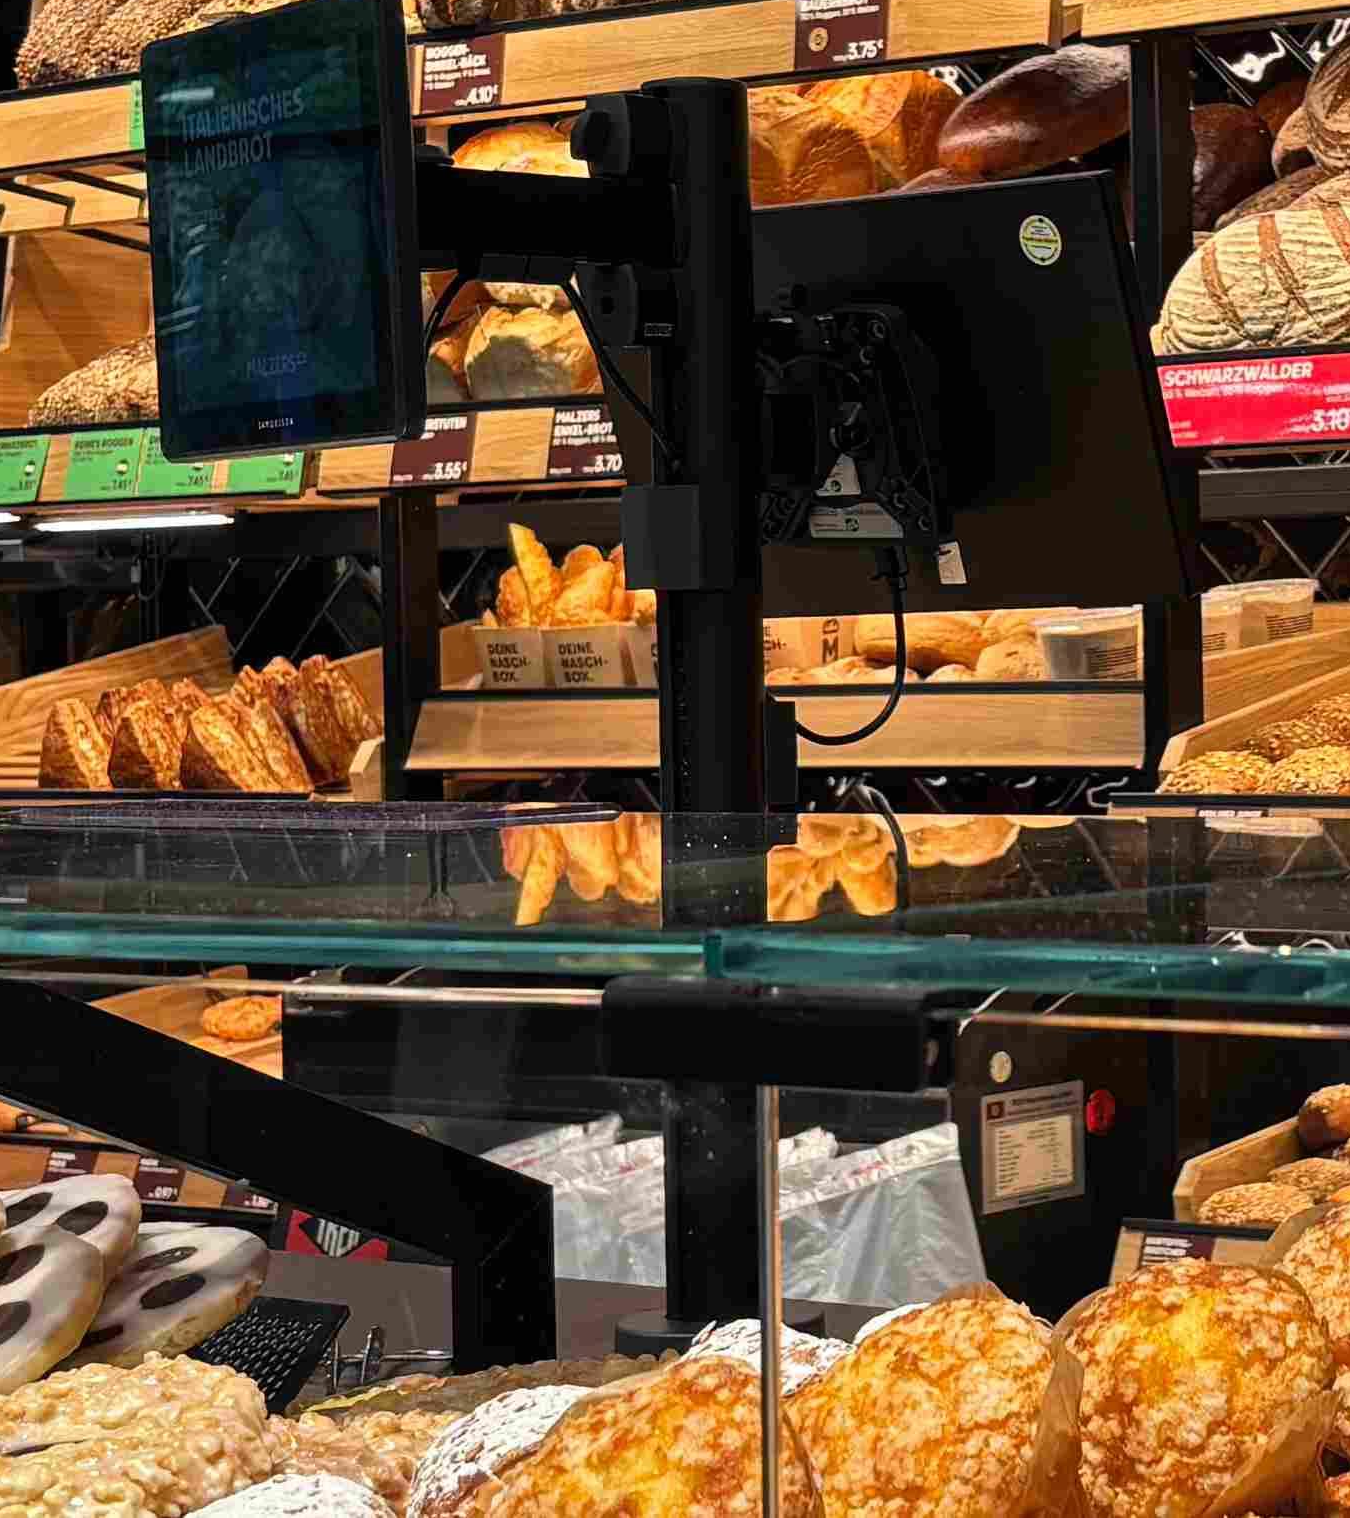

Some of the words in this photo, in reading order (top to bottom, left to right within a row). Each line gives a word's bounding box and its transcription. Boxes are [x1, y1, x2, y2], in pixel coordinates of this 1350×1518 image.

[181, 84, 306, 144] ITALIENISCHES
[184, 130, 274, 180] LANDBROT
[1163, 361, 1314, 387] SCHWARZWÄLDER
[555, 408, 602, 424] MALZERS
[487, 642, 518, 655] DEINE
[558, 642, 594, 655] DEINE
[822, 634, 839, 665] M
[490, 656, 531, 669] NASCH-
[561, 656, 609, 669] NASCH-
[564, 671, 594, 683] BOX.
